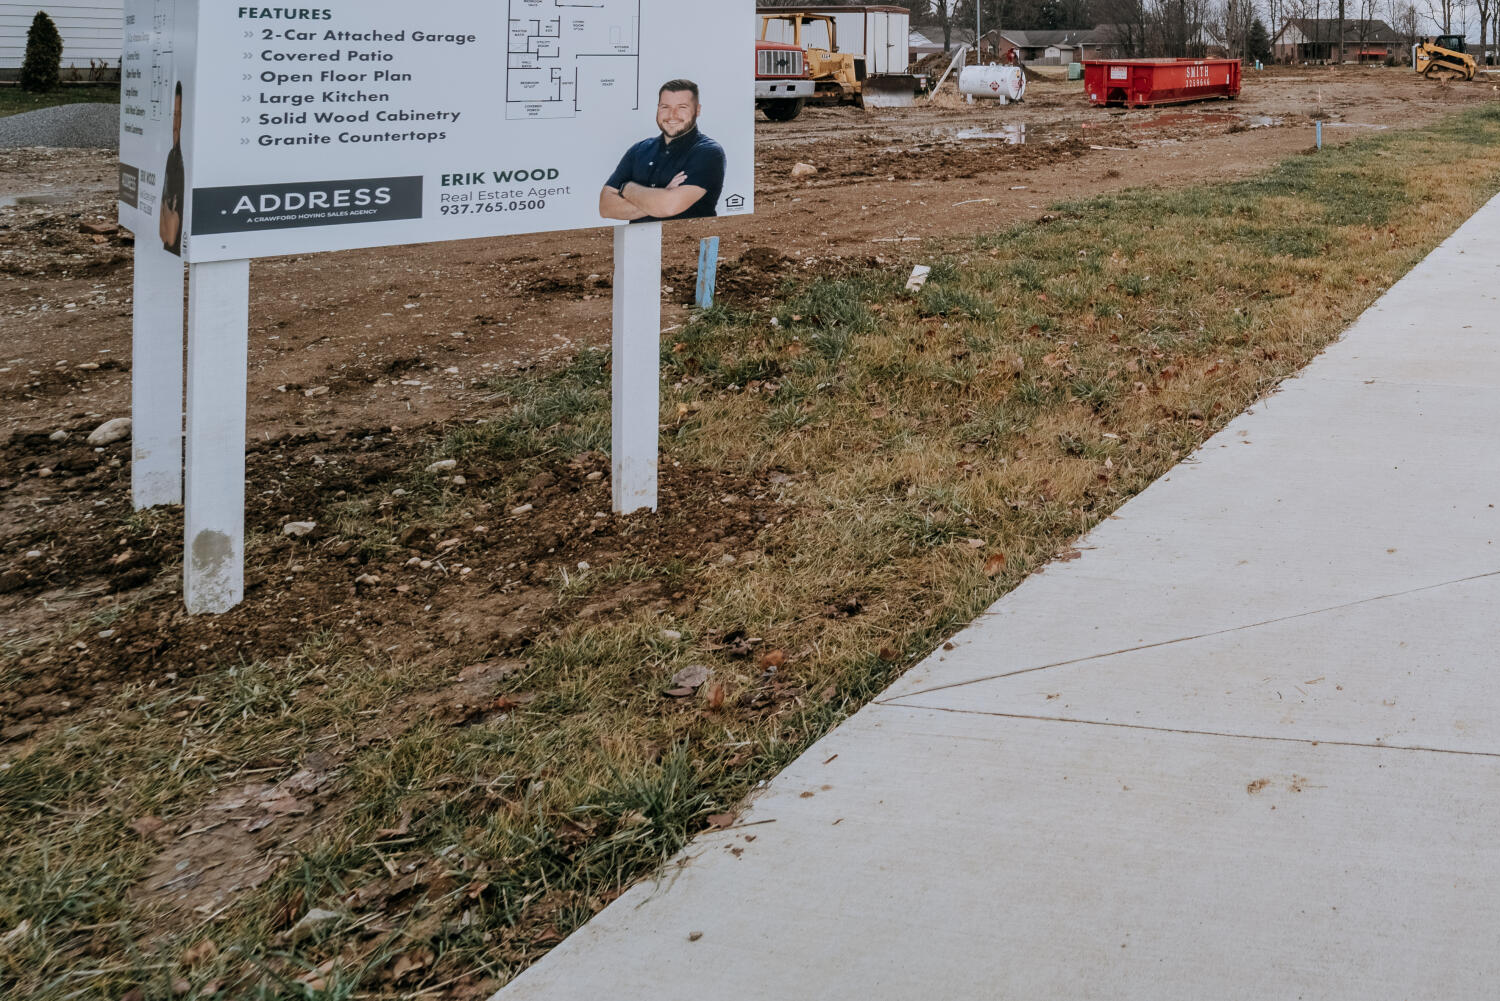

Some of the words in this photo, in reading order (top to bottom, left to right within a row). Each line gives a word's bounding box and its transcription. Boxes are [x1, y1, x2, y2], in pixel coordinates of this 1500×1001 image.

[238, 6, 332, 20] FEATURES
[261, 28, 317, 41] 2-Car
[323, 29, 405, 42] Attached
[412, 30, 477, 45] Garage
[260, 49, 340, 62] Covered
[347, 50, 393, 62] Patio
[260, 70, 313, 85] Open
[320, 70, 367, 82] Floor
[374, 69, 412, 82] Plan
[1186, 65, 1209, 78] SMITH
[259, 92, 315, 106] Large
[322, 90, 389, 103] Kitchen
[259, 112, 307, 125] Solid
[314, 110, 369, 124] Wood
[376, 109, 461, 123] Cabinetry
[258, 132, 331, 146] Granite
[338, 130, 446, 144] Countertops
[441, 171, 486, 186] ERIK
[493, 168, 559, 183] WOOD
[440, 191, 473, 203] Real
[478, 189, 524, 201] Estate
[527, 185, 571, 199] Agent
[327, 210, 349, 218] SALES
[440, 199, 545, 215] 937.765.0500
